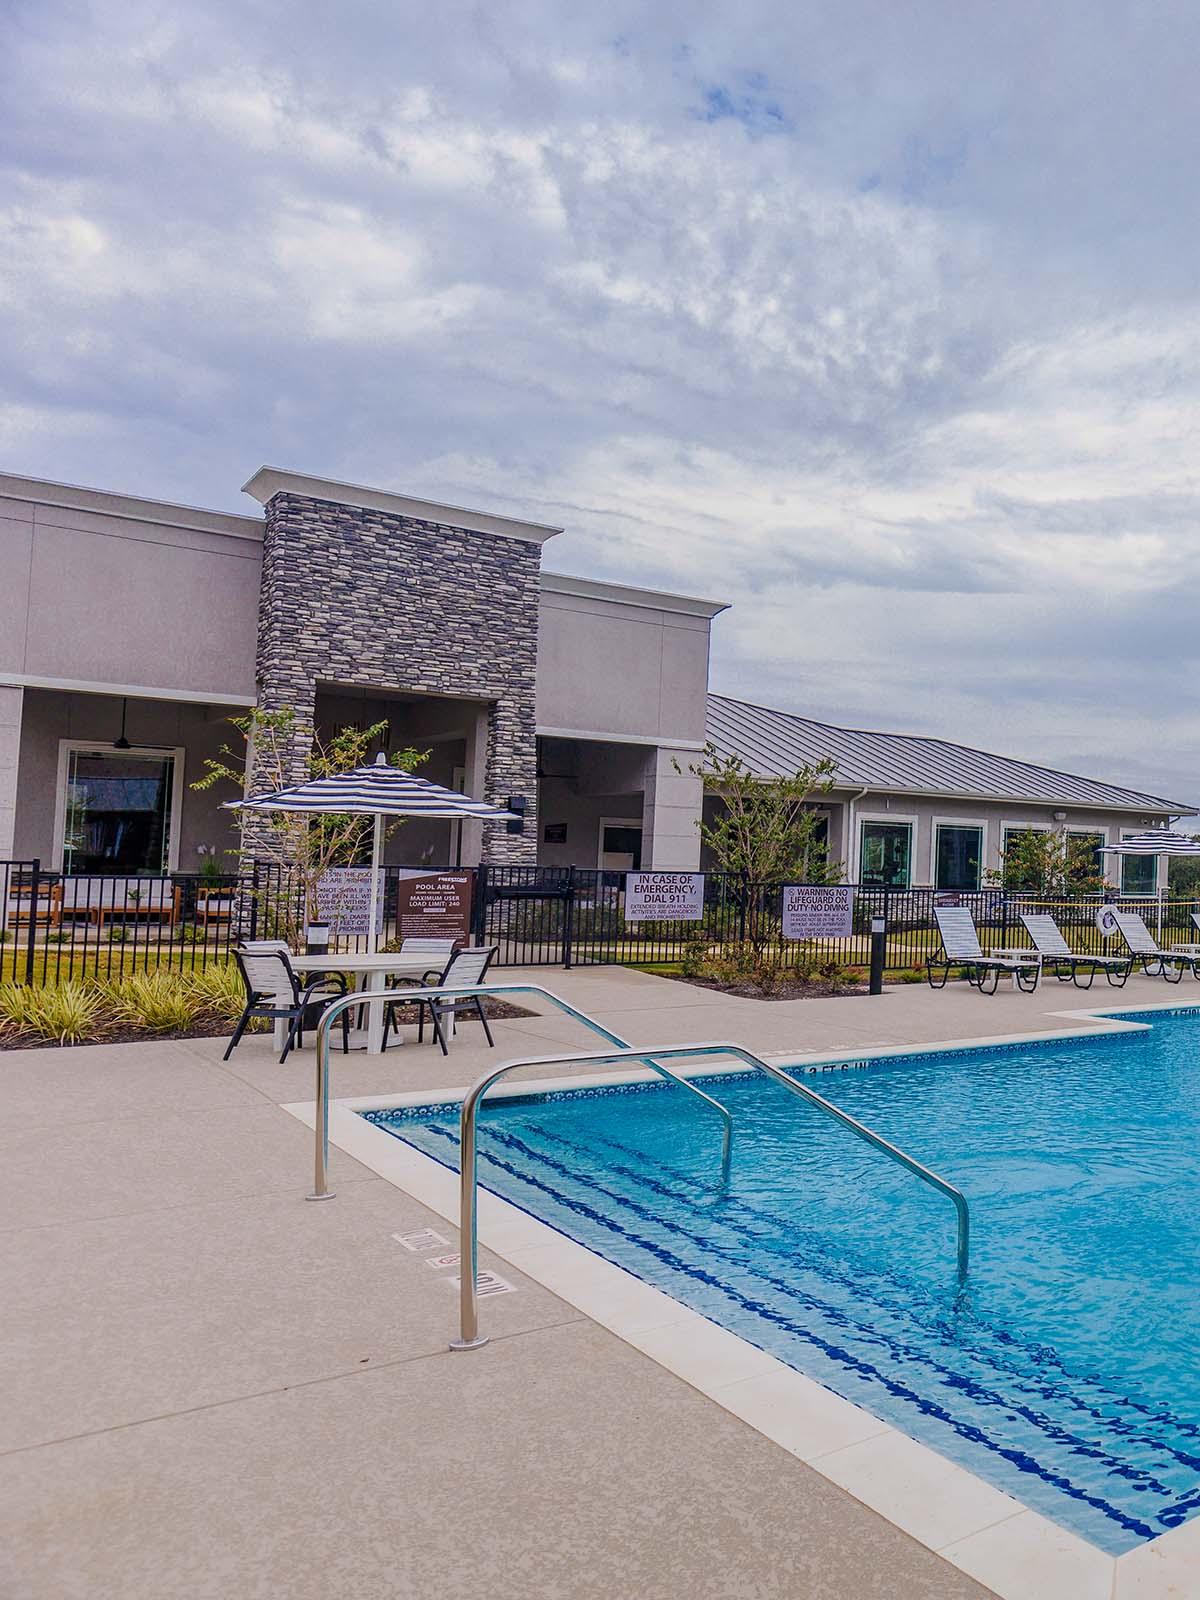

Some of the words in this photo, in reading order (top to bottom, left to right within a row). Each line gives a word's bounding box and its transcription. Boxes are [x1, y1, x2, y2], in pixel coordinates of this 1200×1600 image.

[346, 877, 382, 885] PROHIBITD
[639, 875, 649, 884] IN
[652, 875, 677, 884] CASE
[680, 875, 692, 884] OF
[634, 885, 697, 895] EMERGENCY,
[836, 889, 848, 897] NO
[644, 895, 667, 903] DIAL
[669, 895, 686, 903] 911
[790, 896, 834, 904] LIFEGUARD
[824, 904, 849, 912] DIVING
[822, 1065, 836, 1073] FT
[854, 1062, 867, 1070] IN
